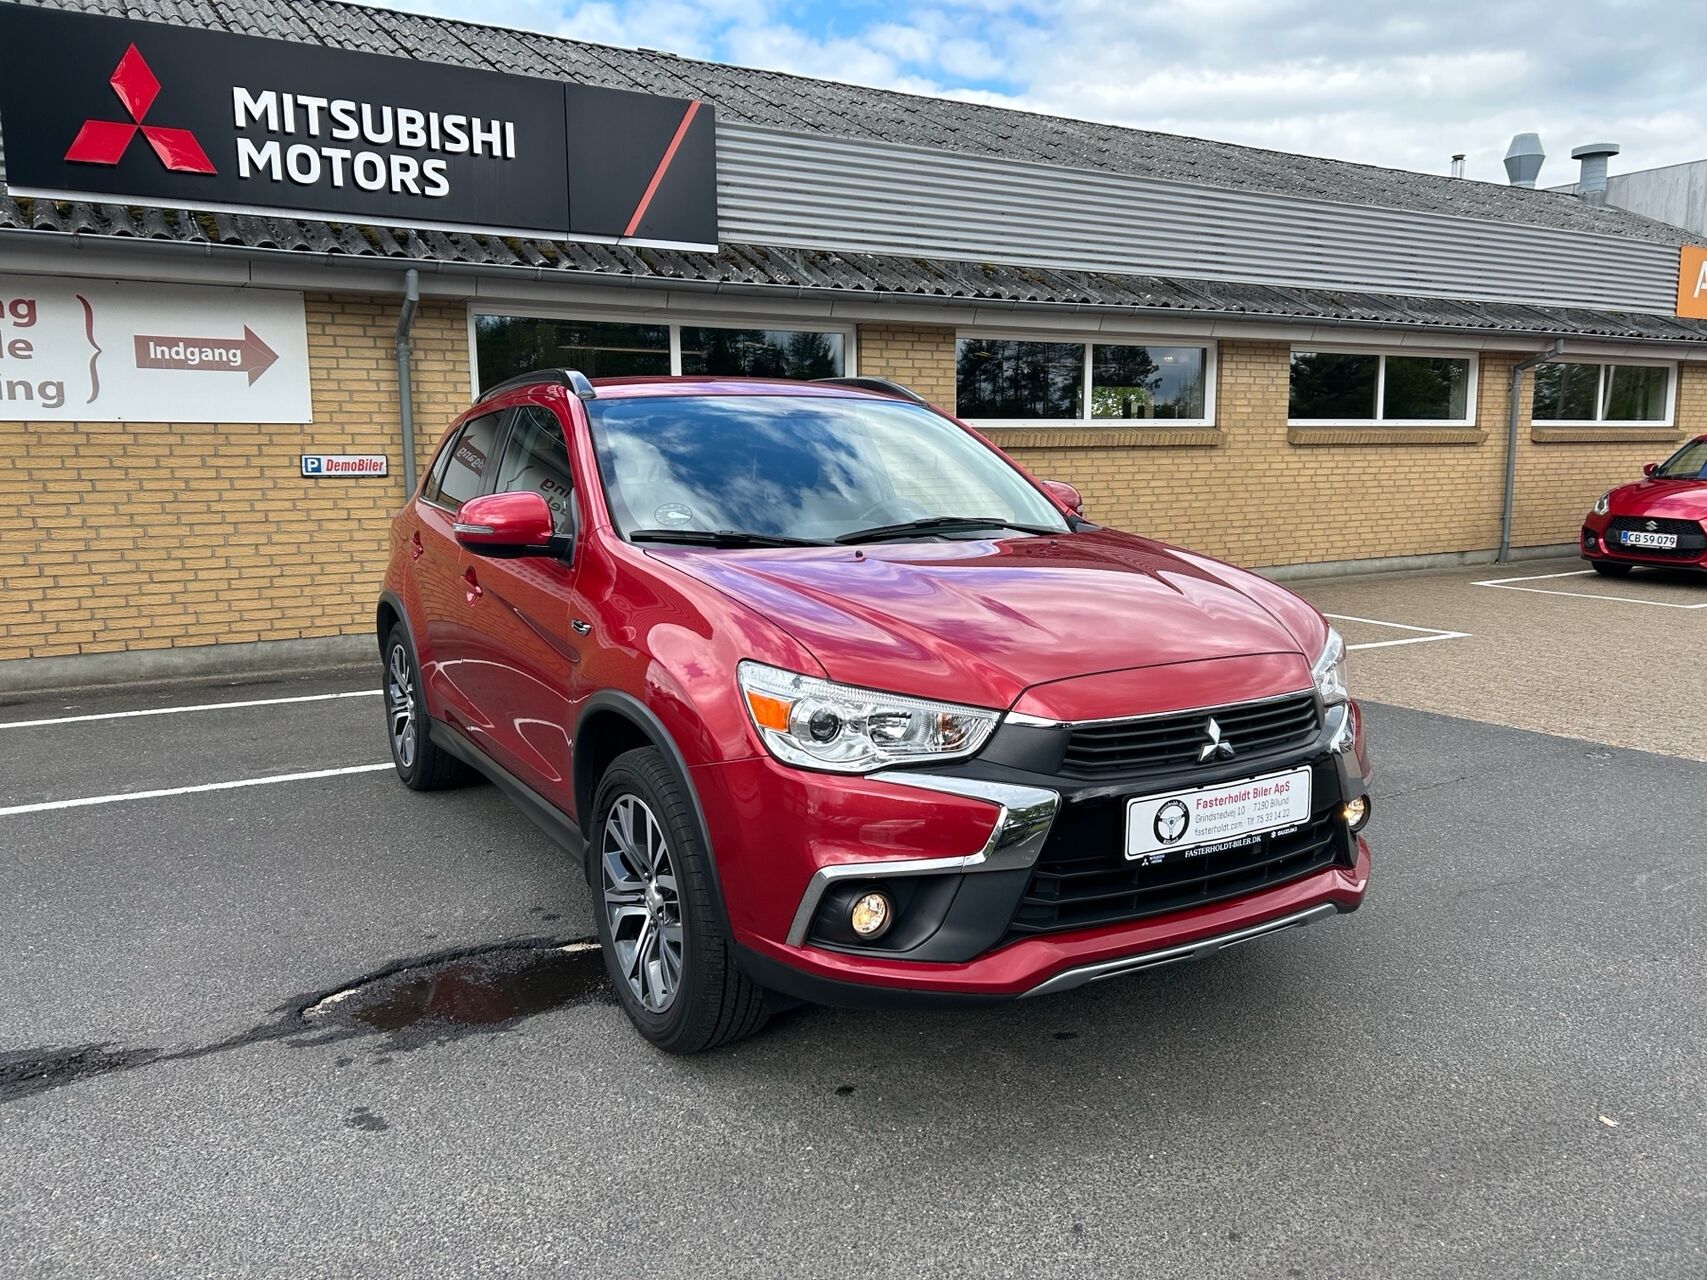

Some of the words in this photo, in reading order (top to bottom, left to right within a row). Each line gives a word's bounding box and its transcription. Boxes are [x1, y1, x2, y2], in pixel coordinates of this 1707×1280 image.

[233, 86, 516, 159] MITSUBISHI
[236, 137, 450, 197] MOTORS
[149, 341, 242, 366] Indgang
[307, 459, 319, 472] P
[326, 459, 384, 472] DemoBiler
[1628, 533, 1641, 543] CB
[1643, 535, 1655, 543] 59
[1657, 536, 1675, 545] 079
[1196, 791, 1250, 810] Fasterholdt
[1253, 787, 1273, 800] Biler
[1273, 781, 1290, 796] ApS
[1195, 807, 1236, 823] Grindstedvej
[1237, 805, 1246, 816] 10
[1256, 814, 1264, 823] 75
[1265, 812, 1273, 822] 33
[1282, 808, 1290, 818] 22
[1185, 835, 1262, 858] FASTERHOLDT-BILER.DK
